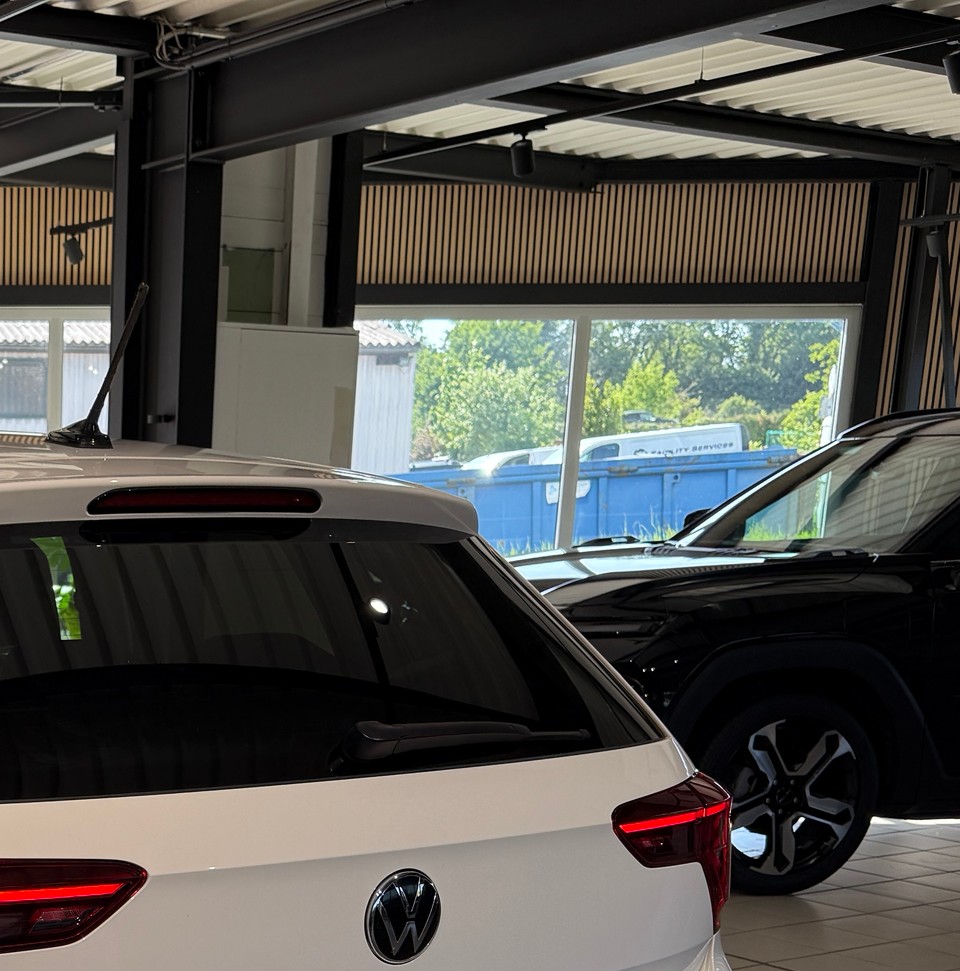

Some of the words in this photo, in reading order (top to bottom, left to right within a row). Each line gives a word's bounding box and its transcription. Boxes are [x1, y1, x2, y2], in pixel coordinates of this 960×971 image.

[651, 447, 690, 455] FACITY
[692, 442, 734, 452] SERVICES
[377, 874, 439, 957] VW
